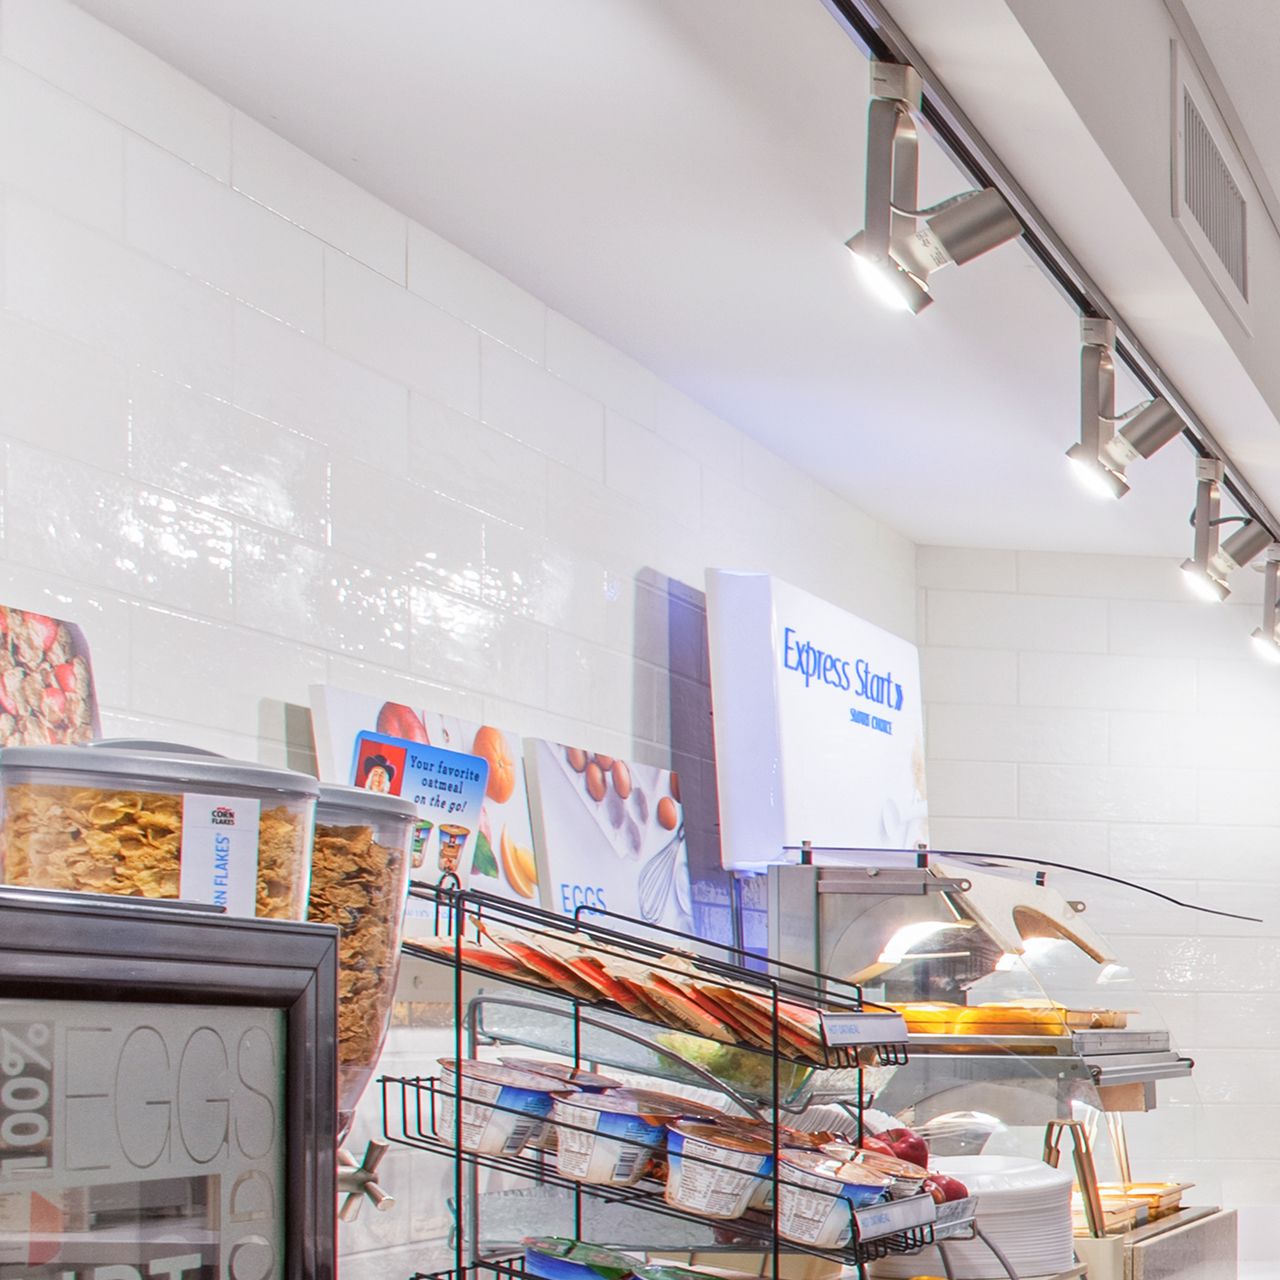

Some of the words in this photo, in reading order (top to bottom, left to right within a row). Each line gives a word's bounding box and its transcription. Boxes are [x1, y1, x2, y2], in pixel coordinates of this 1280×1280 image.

[783, 627, 850, 691] Express
[855, 659, 894, 708] Start
[410, 755, 434, 771] Your
[437, 760, 480, 782] favorite
[421, 778, 464, 794] oatmeal
[211, 810, 235, 818] CORN
[414, 795, 426, 805] on
[429, 795, 447, 809] the
[448, 801, 468, 813] go!
[560, 883, 607, 917] EGGS
[64, 1024, 276, 1172] EGGS
